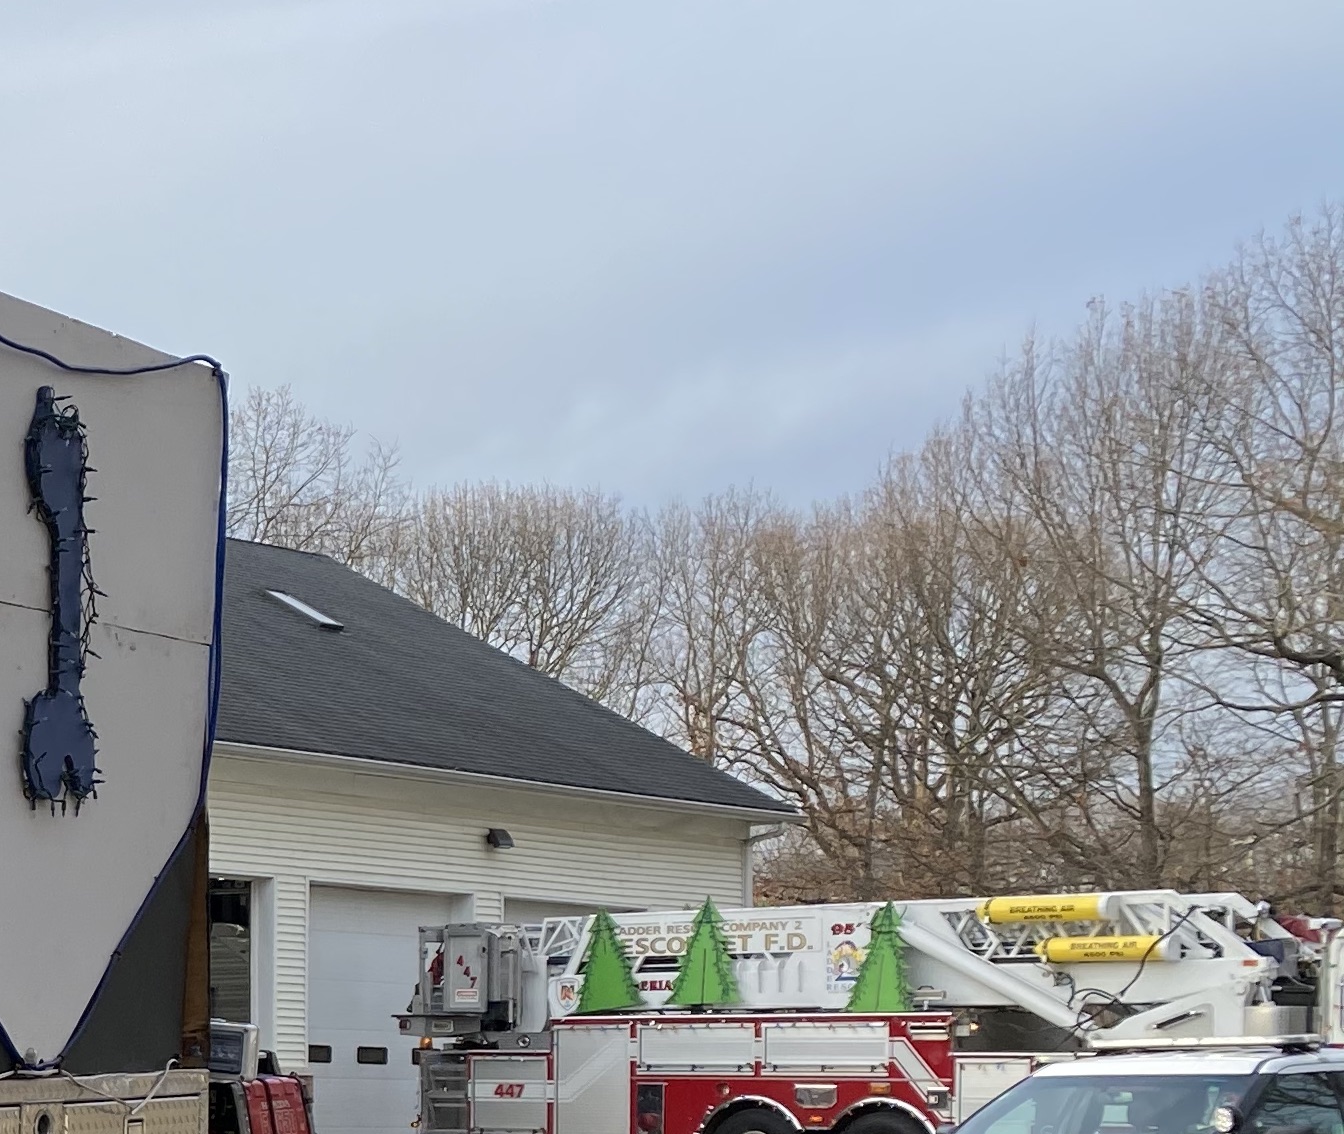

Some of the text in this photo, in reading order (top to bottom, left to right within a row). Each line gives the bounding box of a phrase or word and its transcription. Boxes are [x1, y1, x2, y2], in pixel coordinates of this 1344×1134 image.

[618, 920, 803, 937] ADDER RES COMPANY 2
[764, 932, 814, 951] F.D.
[639, 980, 674, 992] ERIA
[494, 1083, 526, 1099] 447
